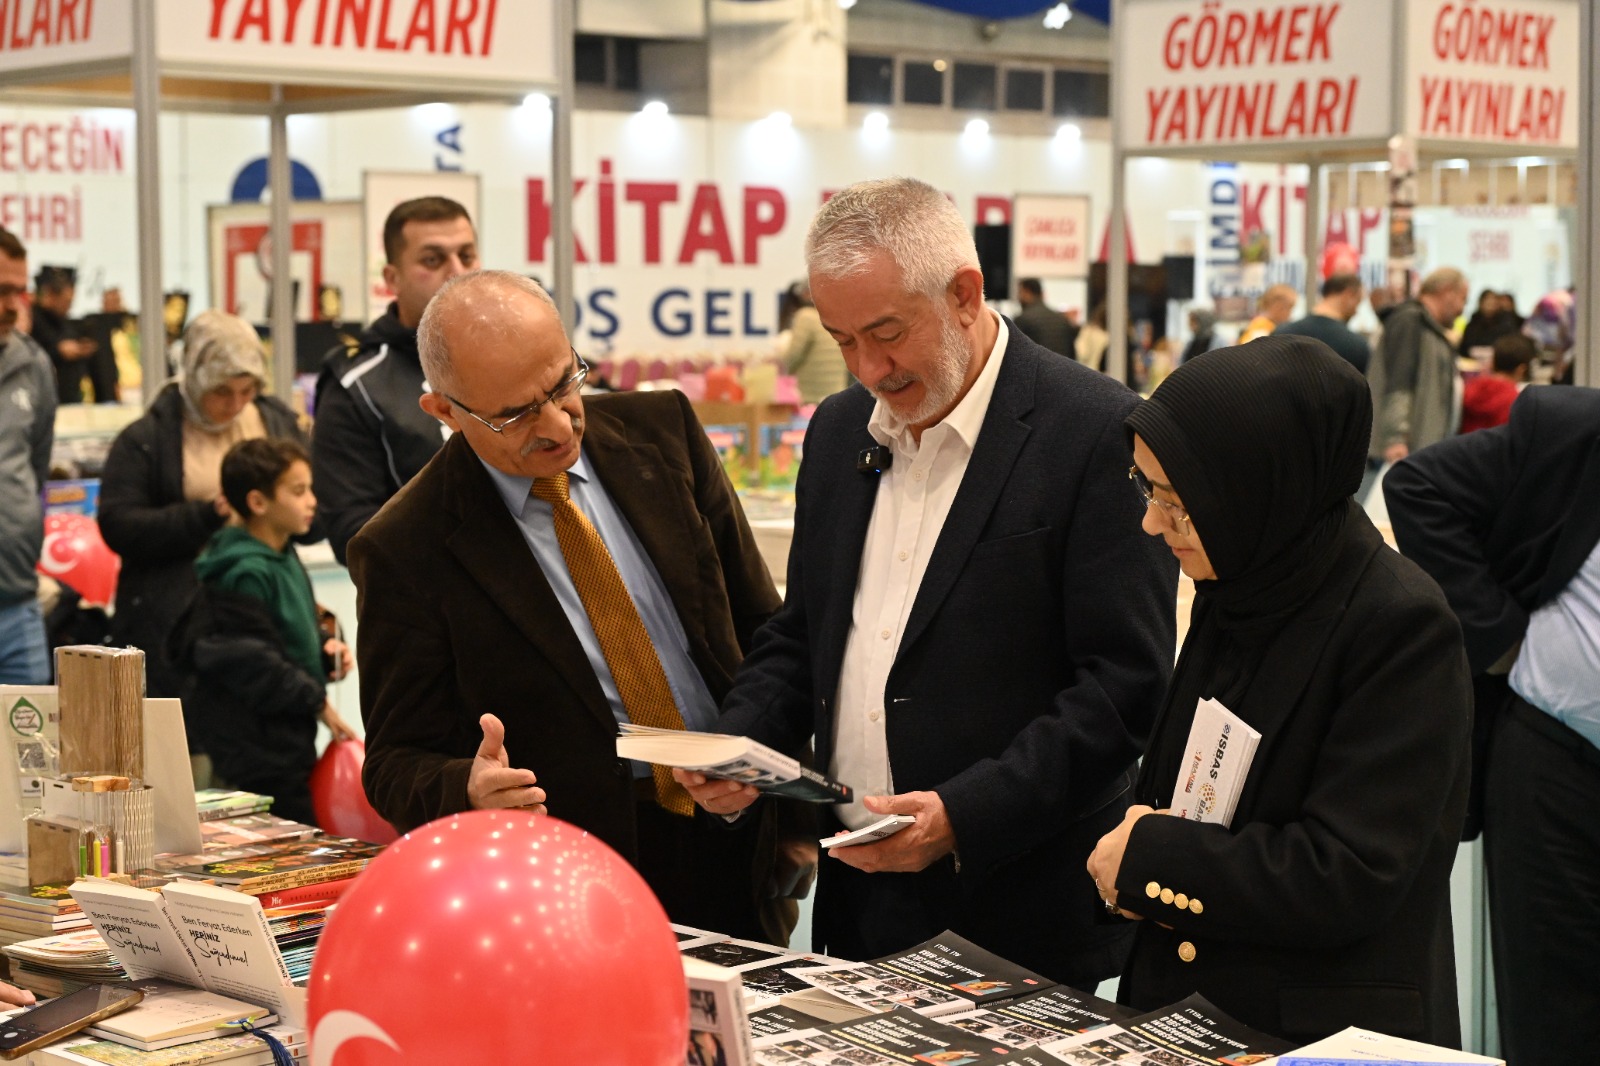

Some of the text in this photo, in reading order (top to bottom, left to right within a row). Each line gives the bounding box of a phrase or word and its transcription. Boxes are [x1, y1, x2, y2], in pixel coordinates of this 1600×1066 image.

[1163, 1, 1340, 71] GÖRMEK
[1432, 0, 1556, 70] GÖRMEK
[1147, 76, 1360, 143] YAYINLARI
[1419, 76, 1566, 142] YAYINLARI
[526, 159, 787, 264] KİTAP
